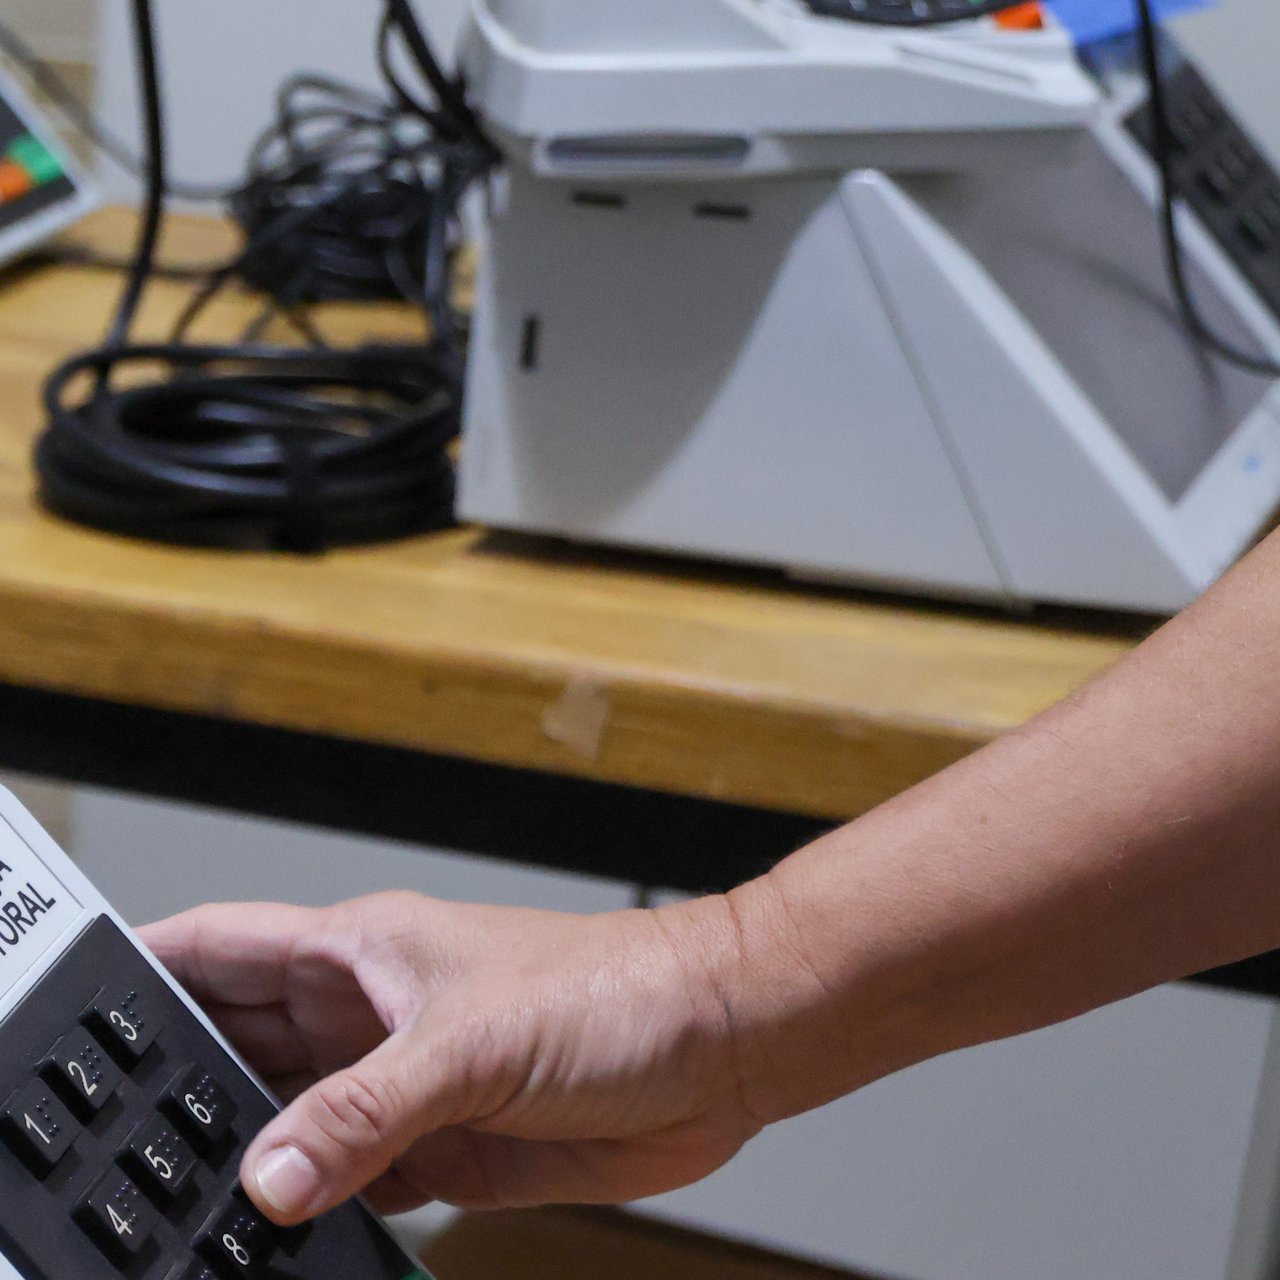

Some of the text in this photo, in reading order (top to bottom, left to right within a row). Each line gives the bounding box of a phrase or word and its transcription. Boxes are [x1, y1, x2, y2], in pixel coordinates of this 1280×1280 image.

[109, 1010, 137, 1041] 3
[68, 1061, 98, 1096] 2
[184, 1093, 212, 1125] 6
[24, 1113, 50, 1144] 1
[144, 1145, 172, 1179] 5
[106, 1204, 133, 1235] 4
[222, 1233, 250, 1266] 8
